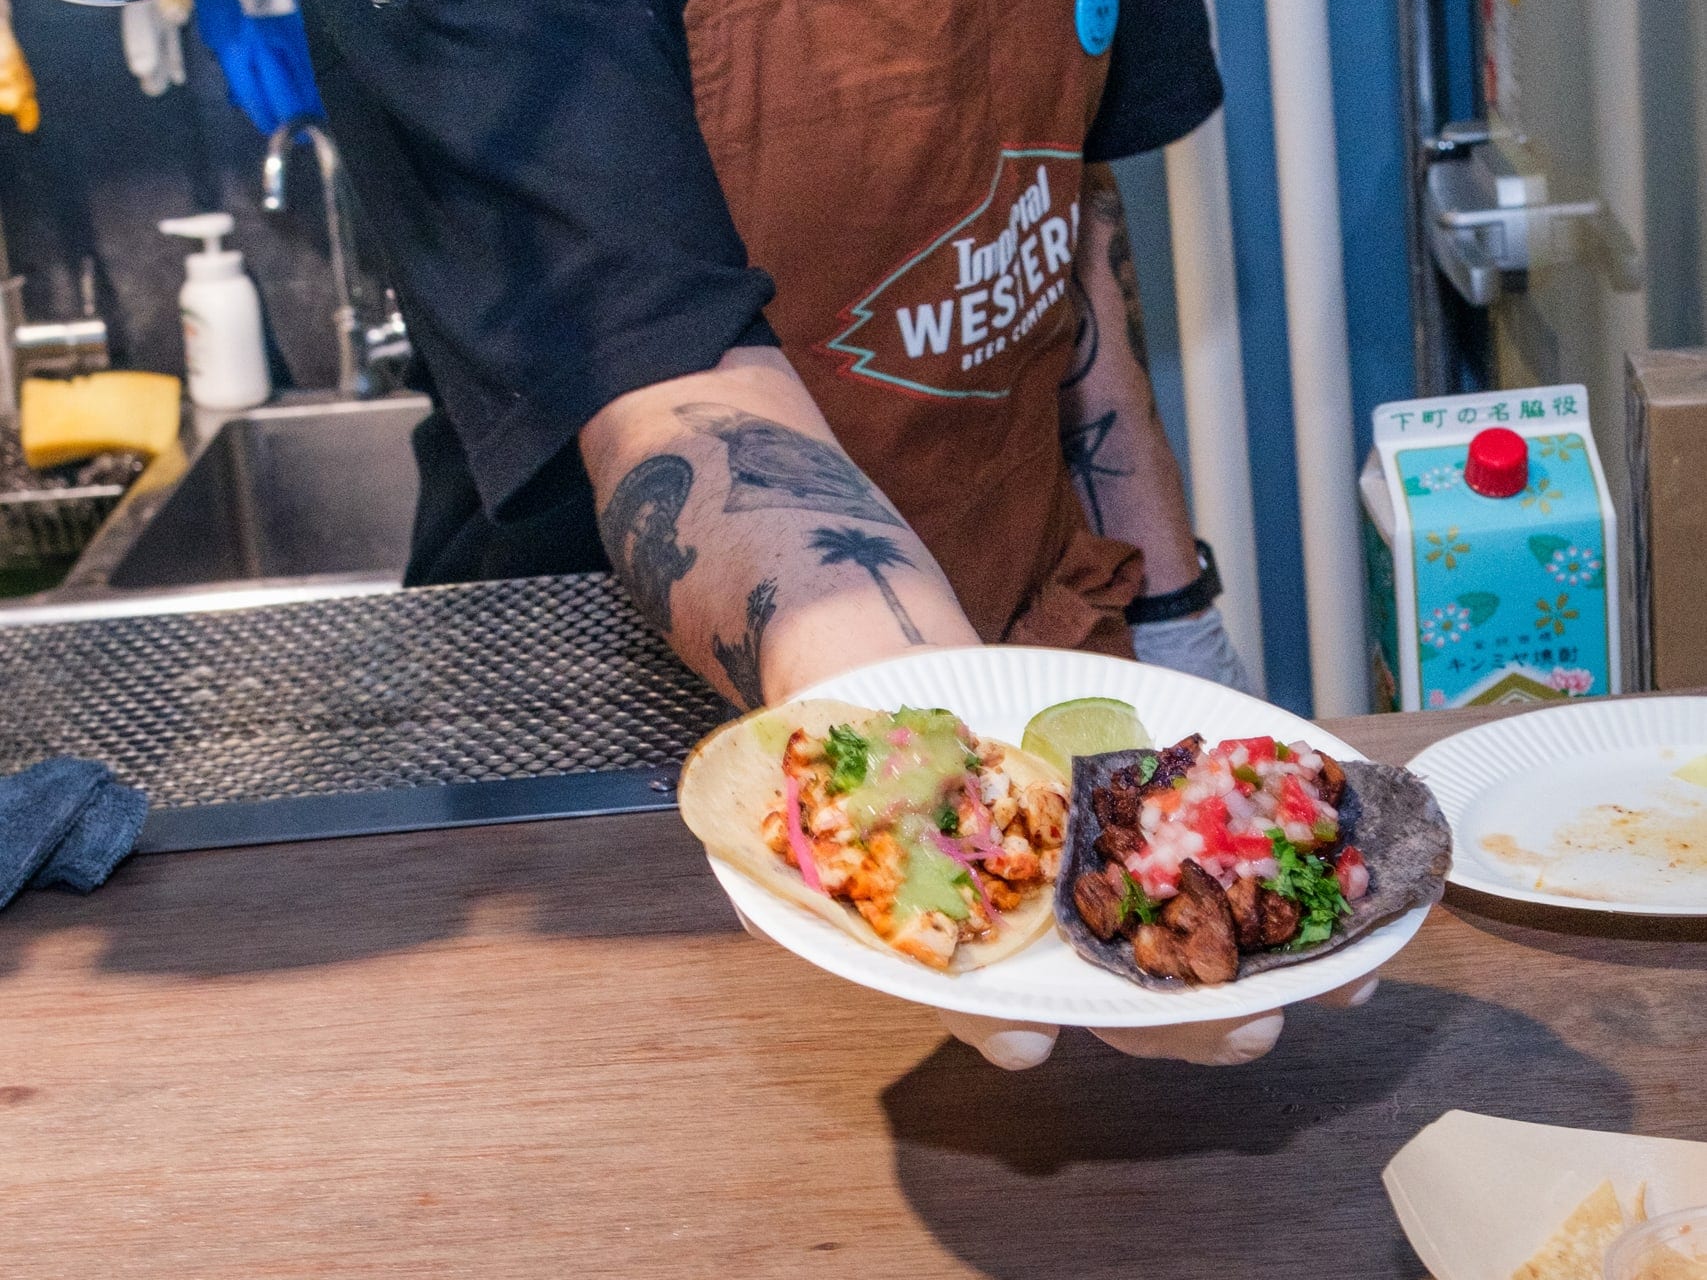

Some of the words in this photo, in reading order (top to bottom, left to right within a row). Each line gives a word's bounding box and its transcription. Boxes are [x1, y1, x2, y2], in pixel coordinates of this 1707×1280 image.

[1391, 395, 1578, 432] 下町の名脇役
